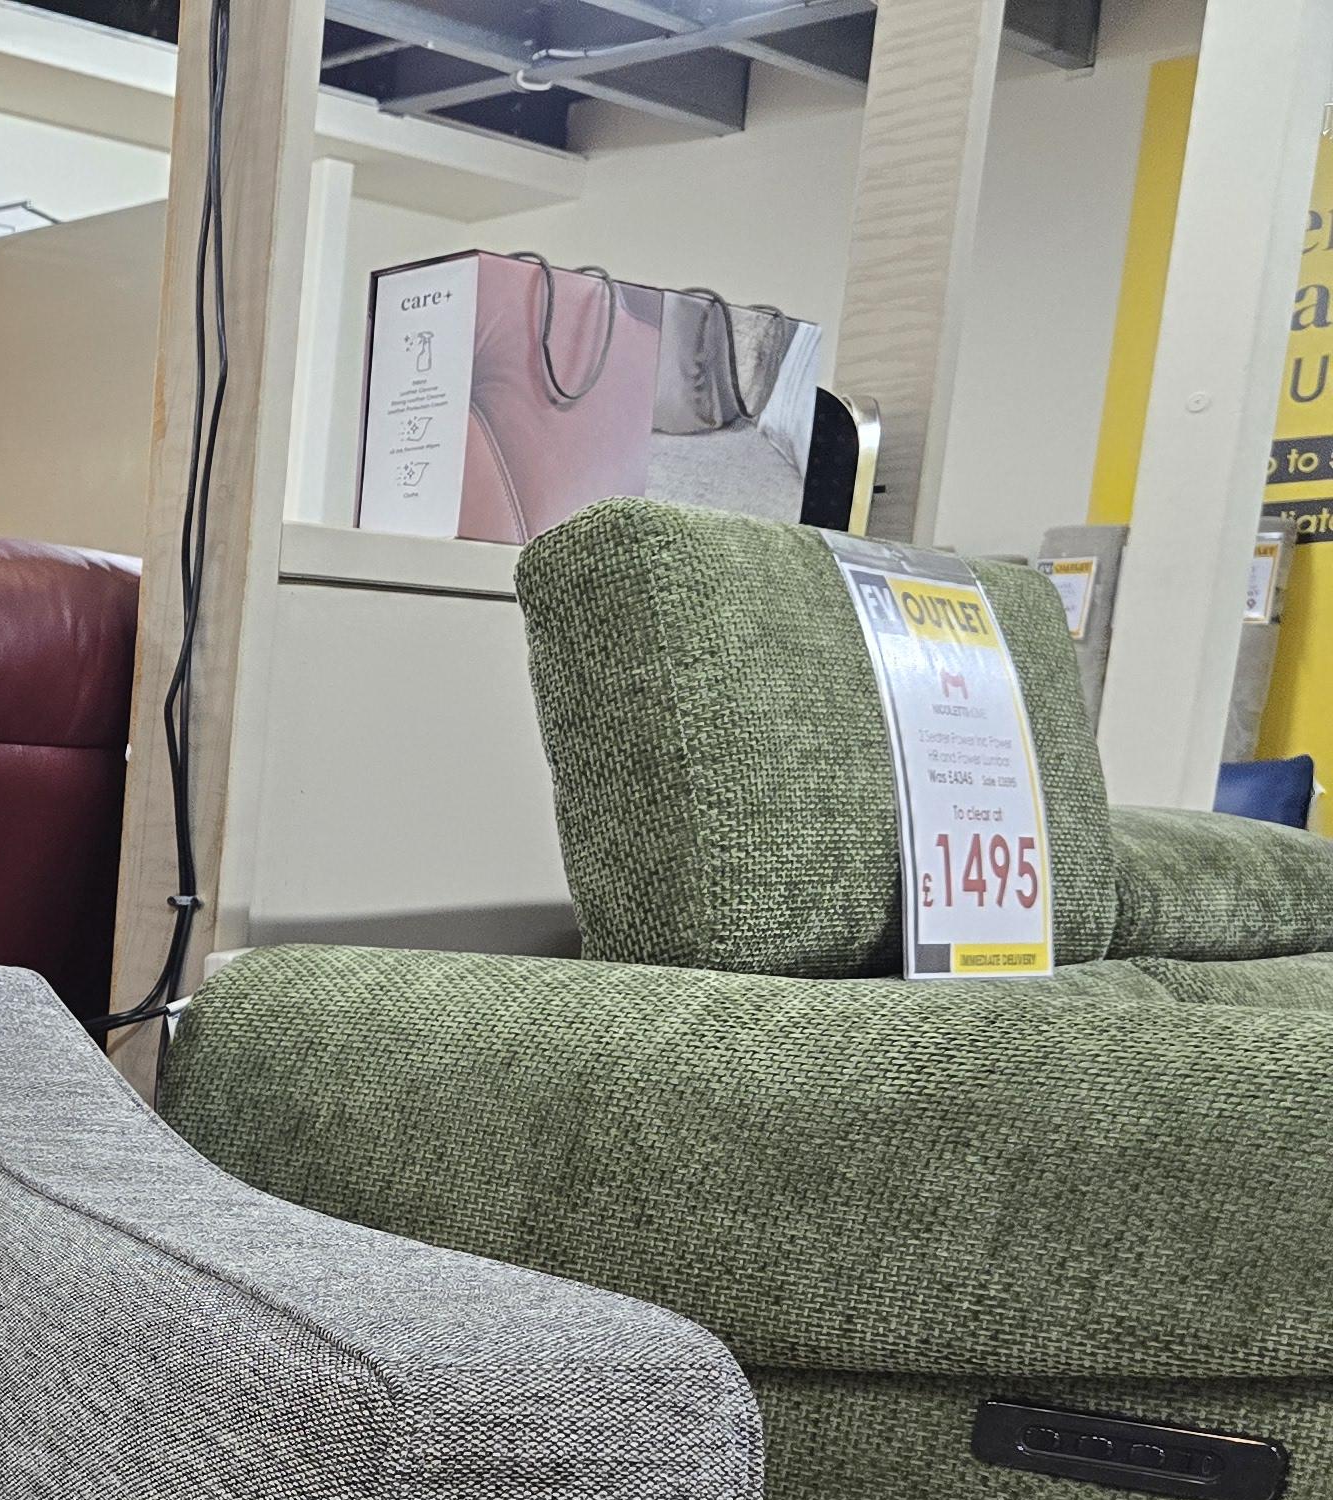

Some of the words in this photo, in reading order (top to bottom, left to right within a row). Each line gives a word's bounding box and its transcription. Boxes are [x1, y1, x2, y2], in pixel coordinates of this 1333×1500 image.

[401, 290, 452, 312] care+
[1287, 448, 1319, 474] to
[901, 591, 989, 635] OUTLET
[953, 805, 964, 820] To
[967, 806, 990, 822] clear
[922, 833, 1038, 909] £1495
